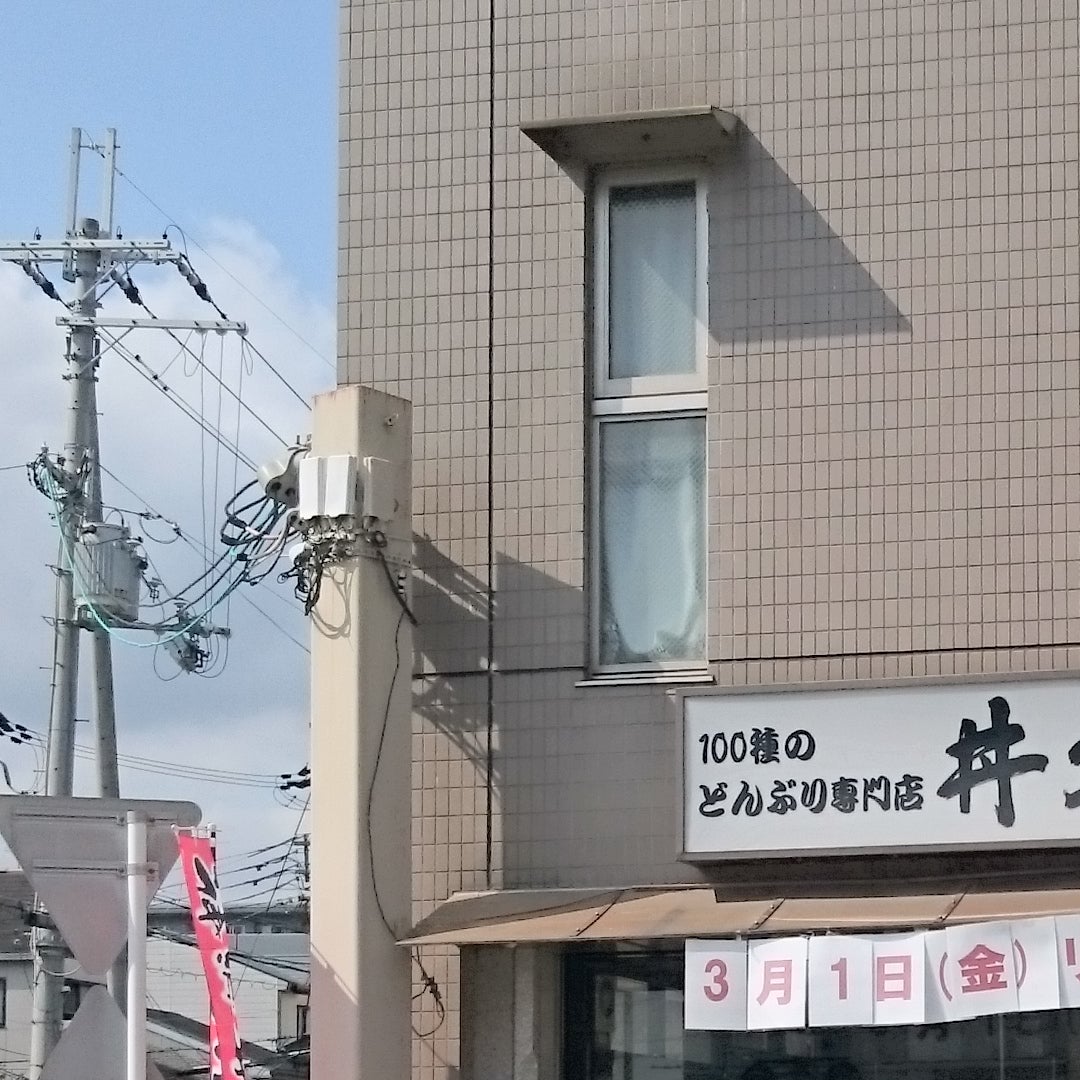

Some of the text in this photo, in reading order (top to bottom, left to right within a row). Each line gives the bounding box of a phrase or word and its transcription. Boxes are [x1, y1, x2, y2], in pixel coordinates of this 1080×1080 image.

[699, 727, 816, 766] 100種の
[698, 776, 924, 818] どんぶり専門店
